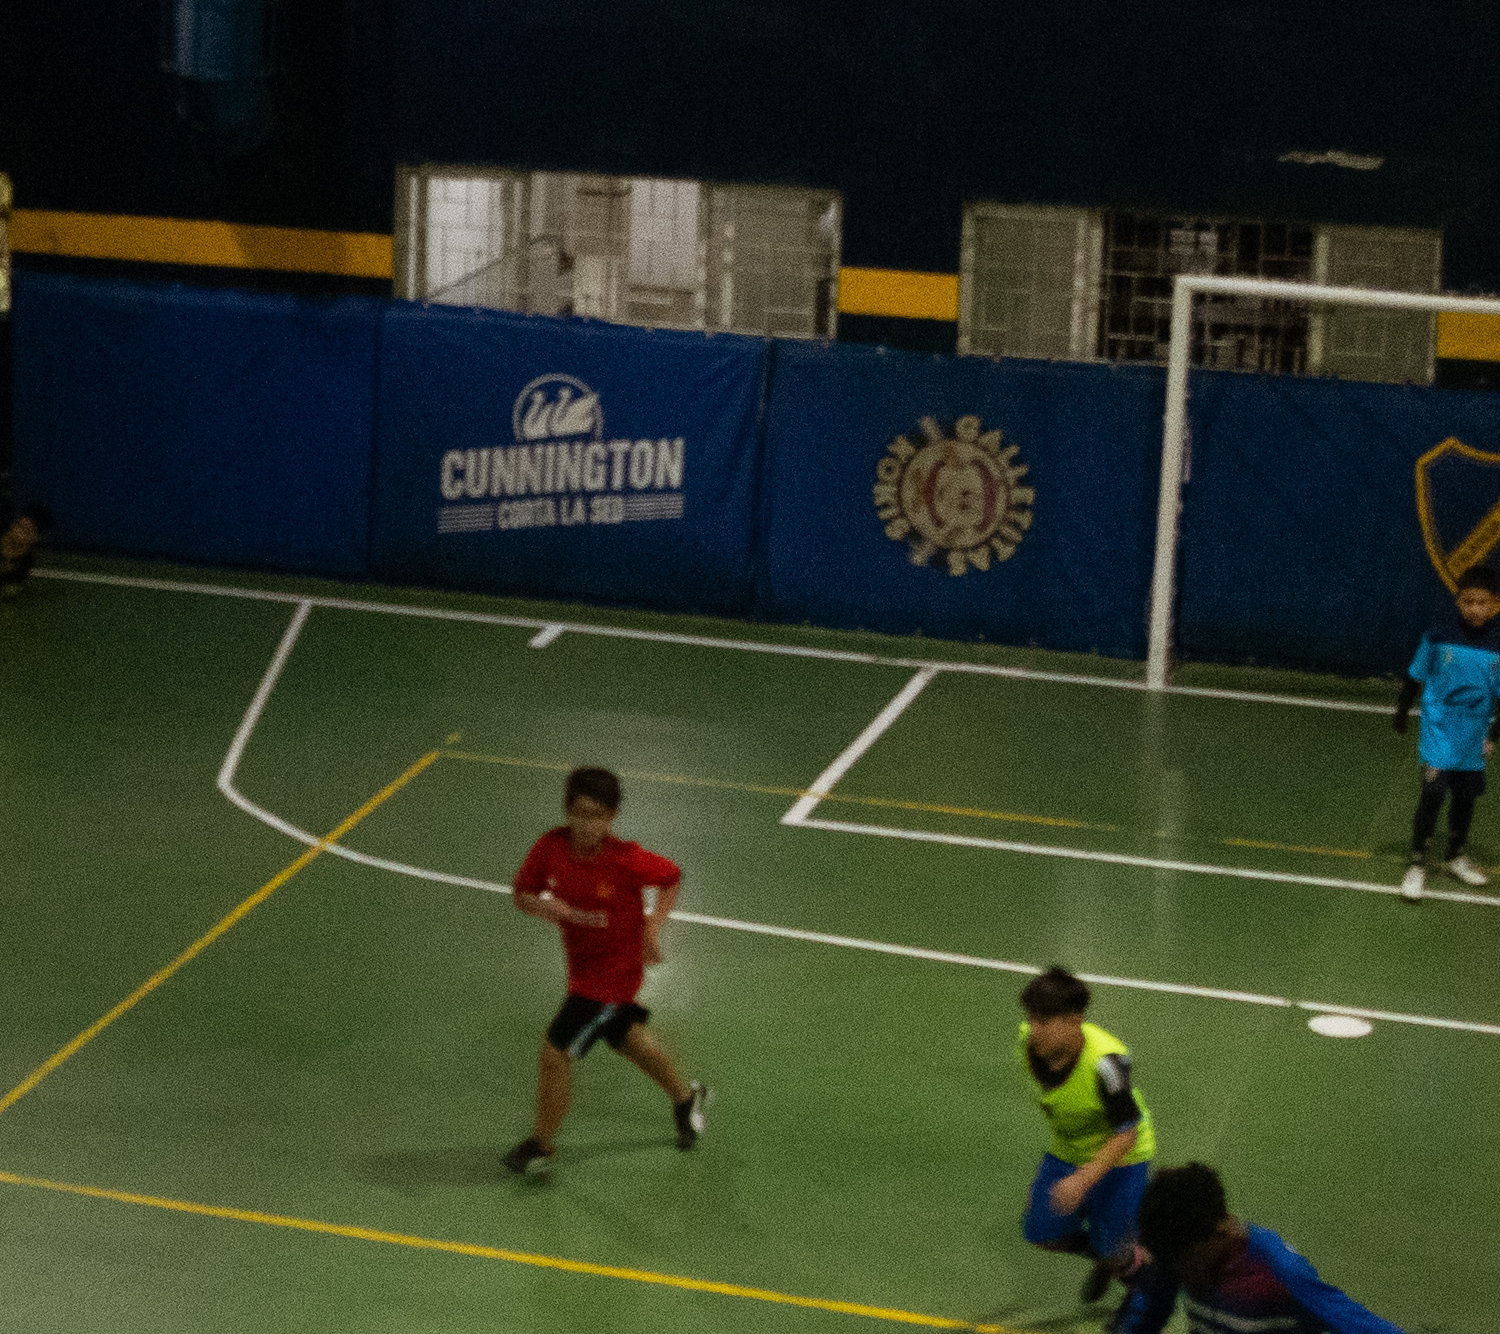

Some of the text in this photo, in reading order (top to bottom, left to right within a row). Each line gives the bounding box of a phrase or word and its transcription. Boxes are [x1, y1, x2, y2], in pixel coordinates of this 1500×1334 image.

[440, 436, 685, 501] CUNNINGTON
[561, 497, 587, 526] LA
[590, 495, 626, 524] SED
